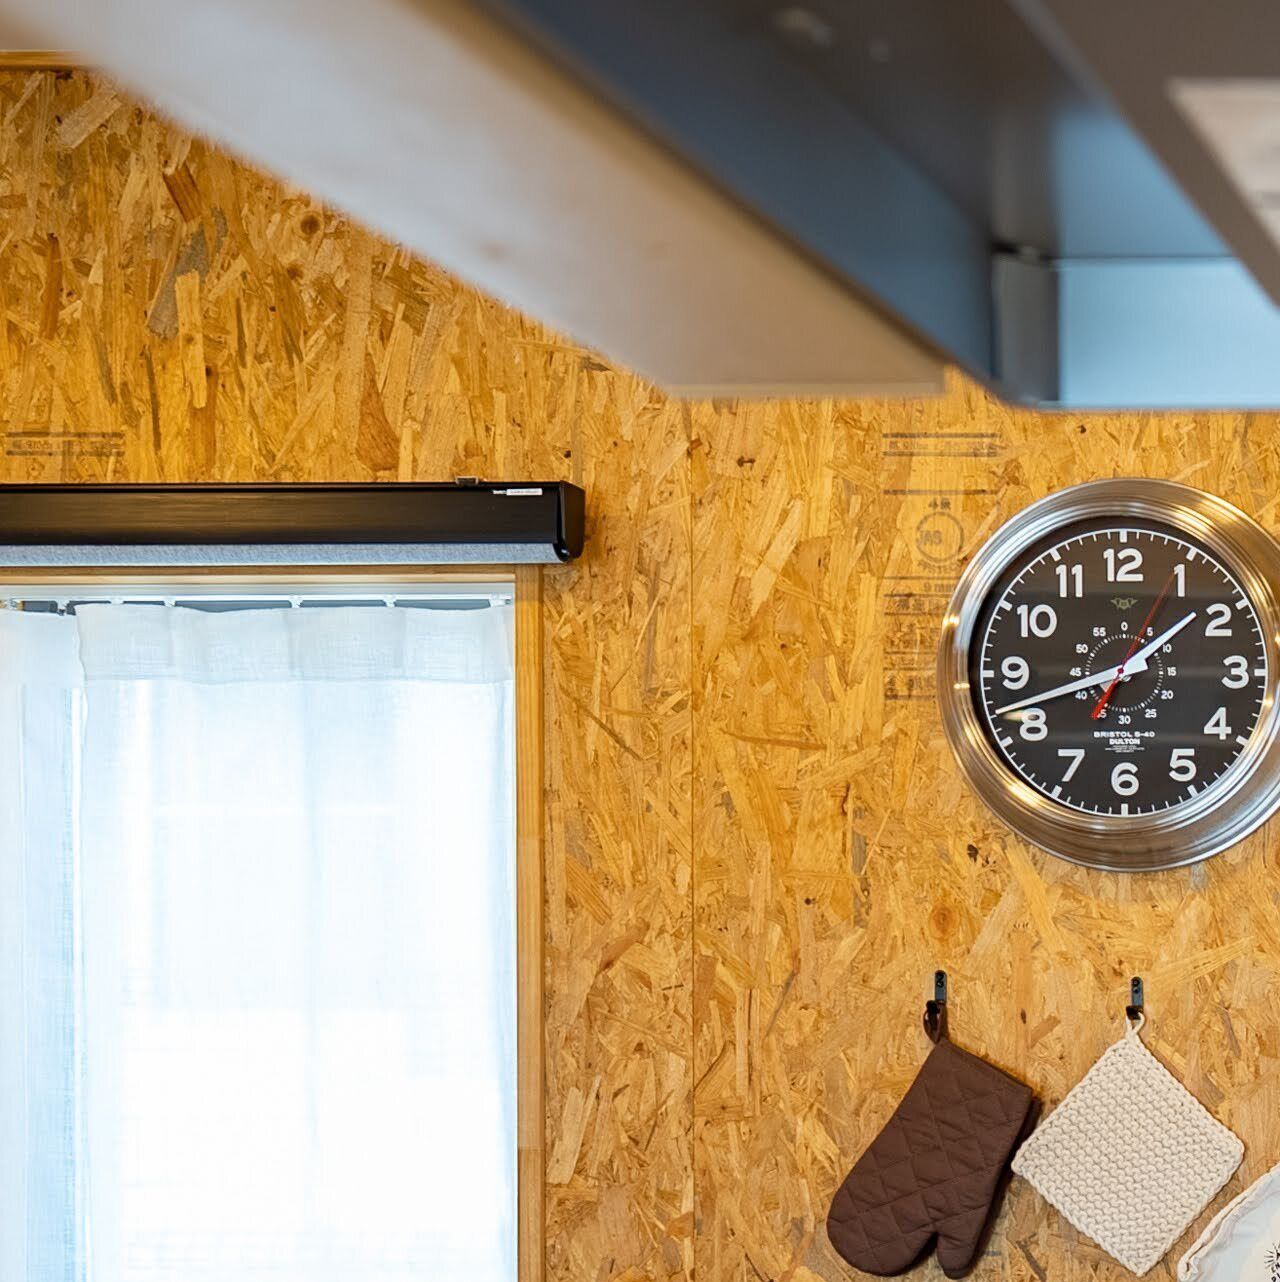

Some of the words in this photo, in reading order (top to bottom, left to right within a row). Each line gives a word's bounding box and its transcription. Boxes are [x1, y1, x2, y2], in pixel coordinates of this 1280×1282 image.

[1103, 548, 1143, 581] 12
[1174, 564, 1185, 597] 1
[1056, 565, 1082, 597] 11
[1017, 605, 1057, 637] 10
[1093, 627, 1106, 637] 55
[1205, 604, 1232, 636] 2
[1002, 656, 1029, 689] 9
[1222, 656, 1249, 688] 3
[1161, 690, 1174, 700] 20
[1019, 707, 1048, 741] 8
[1118, 715, 1131, 725] 30
[1145, 708, 1157, 718] 25
[1204, 707, 1231, 740] 4
[1058, 749, 1085, 781] 7
[1111, 763, 1139, 795] 6
[1169, 749, 1196, 781] 5
